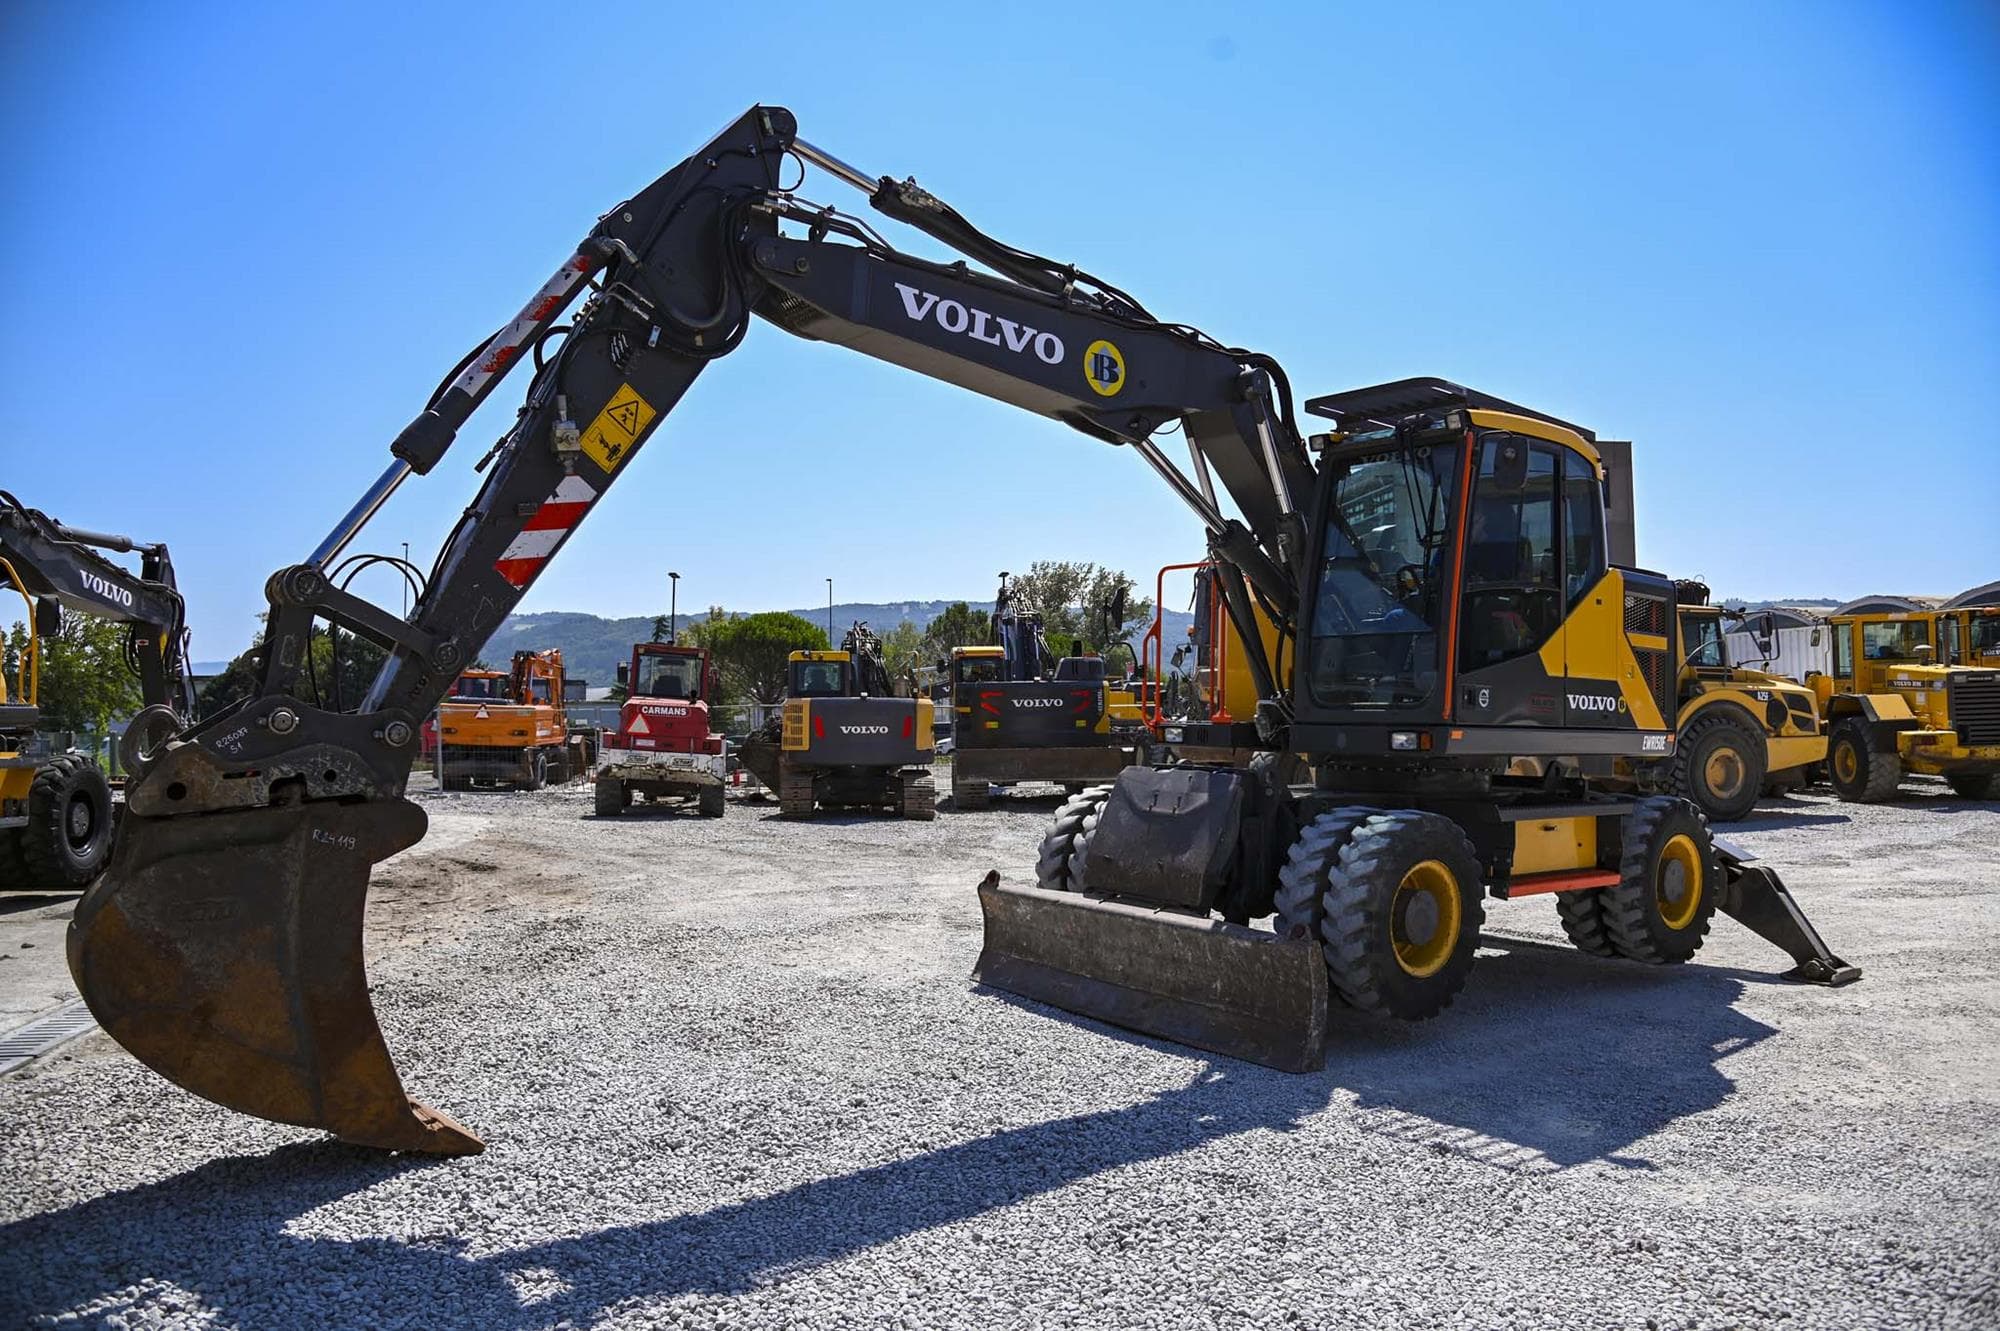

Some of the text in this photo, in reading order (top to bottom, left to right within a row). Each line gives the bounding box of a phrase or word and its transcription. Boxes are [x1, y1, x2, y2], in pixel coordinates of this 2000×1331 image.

[894, 282, 1065, 365] VOLVO
[1091, 351, 1120, 384] B
[79, 569, 132, 606] VOLVO
[641, 706, 687, 715] CARMANS
[1012, 698, 1063, 707] VOLVO
[1566, 694, 1616, 711] VOLVO
[840, 725, 888, 734] VOLVO
[1642, 735, 1666, 750] EWR150E
[312, 829, 356, 850] R24119
